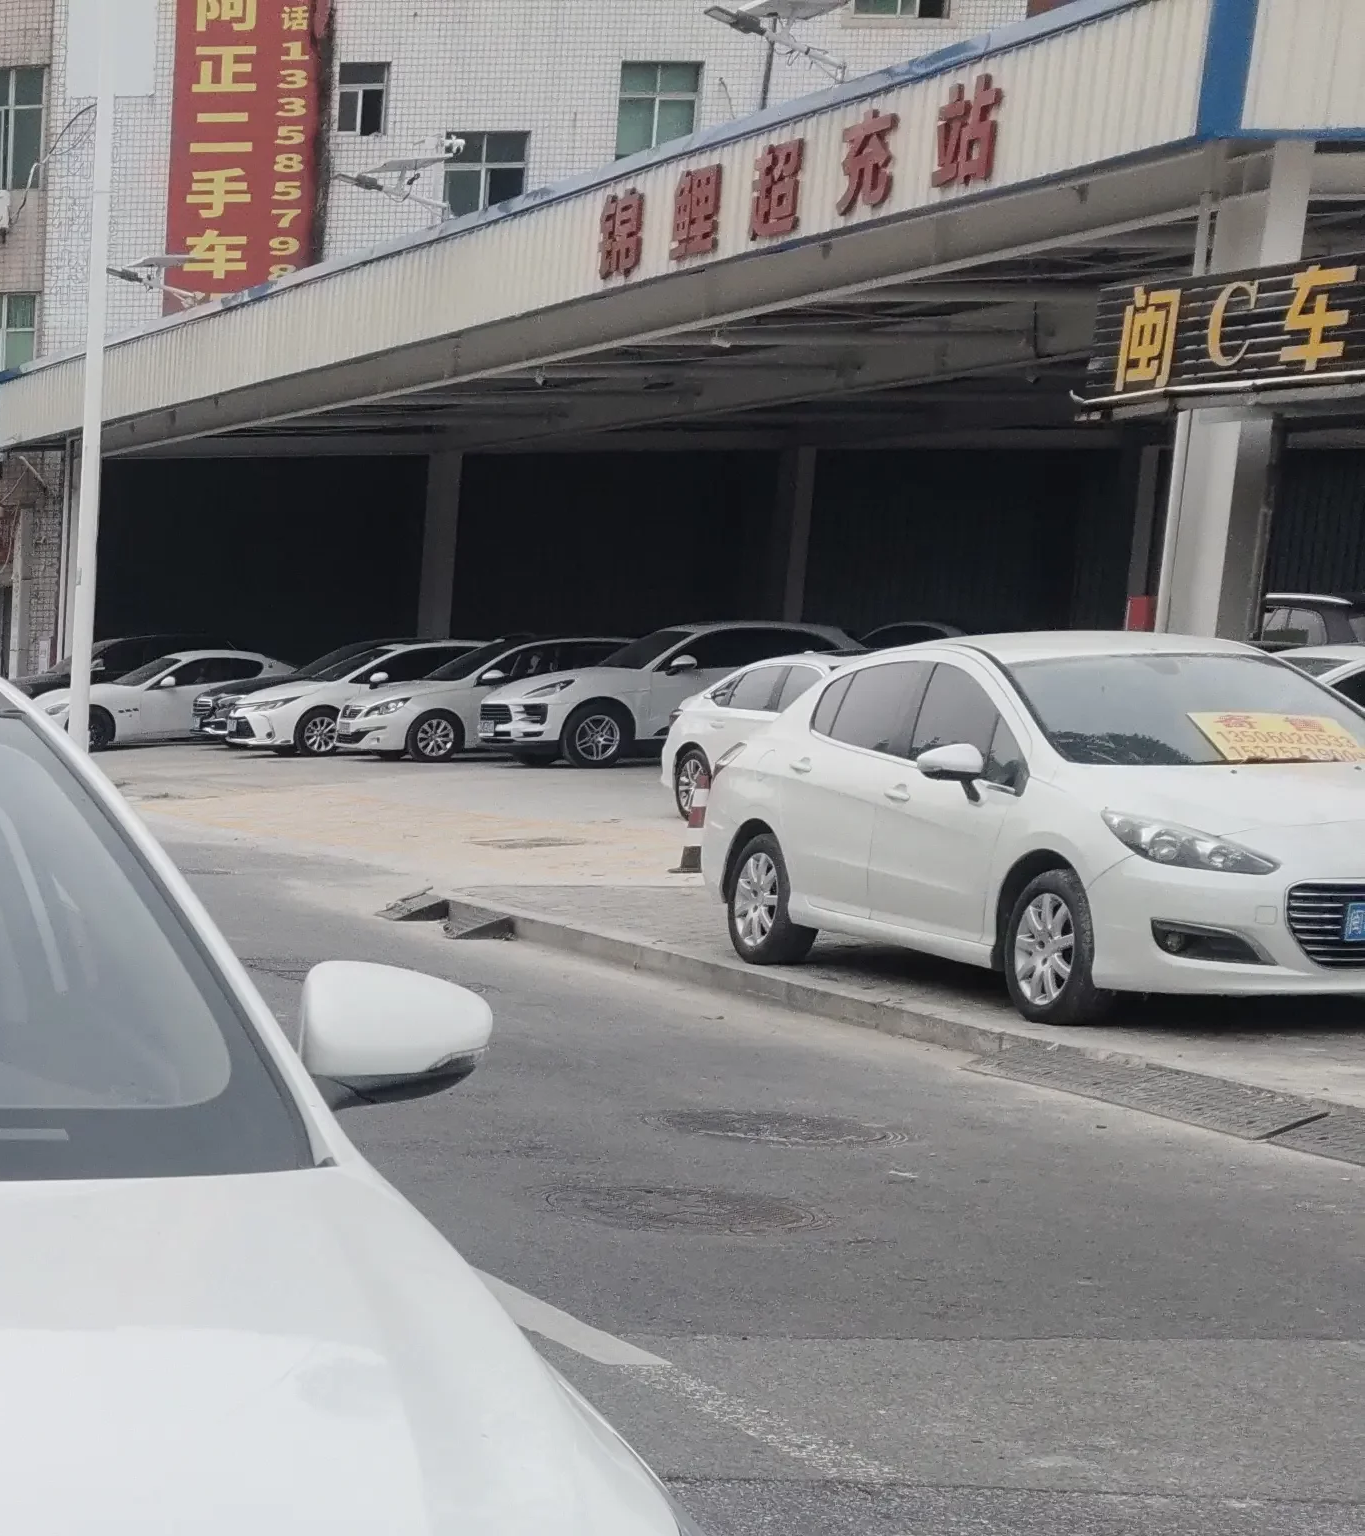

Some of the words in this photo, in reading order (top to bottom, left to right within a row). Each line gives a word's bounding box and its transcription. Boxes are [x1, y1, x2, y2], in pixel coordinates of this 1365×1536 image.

[182, 0, 257, 305] 阿正二手车
[598, 73, 1004, 280] 锦鲤超充站
[1114, 264, 1357, 391] 闽C车
